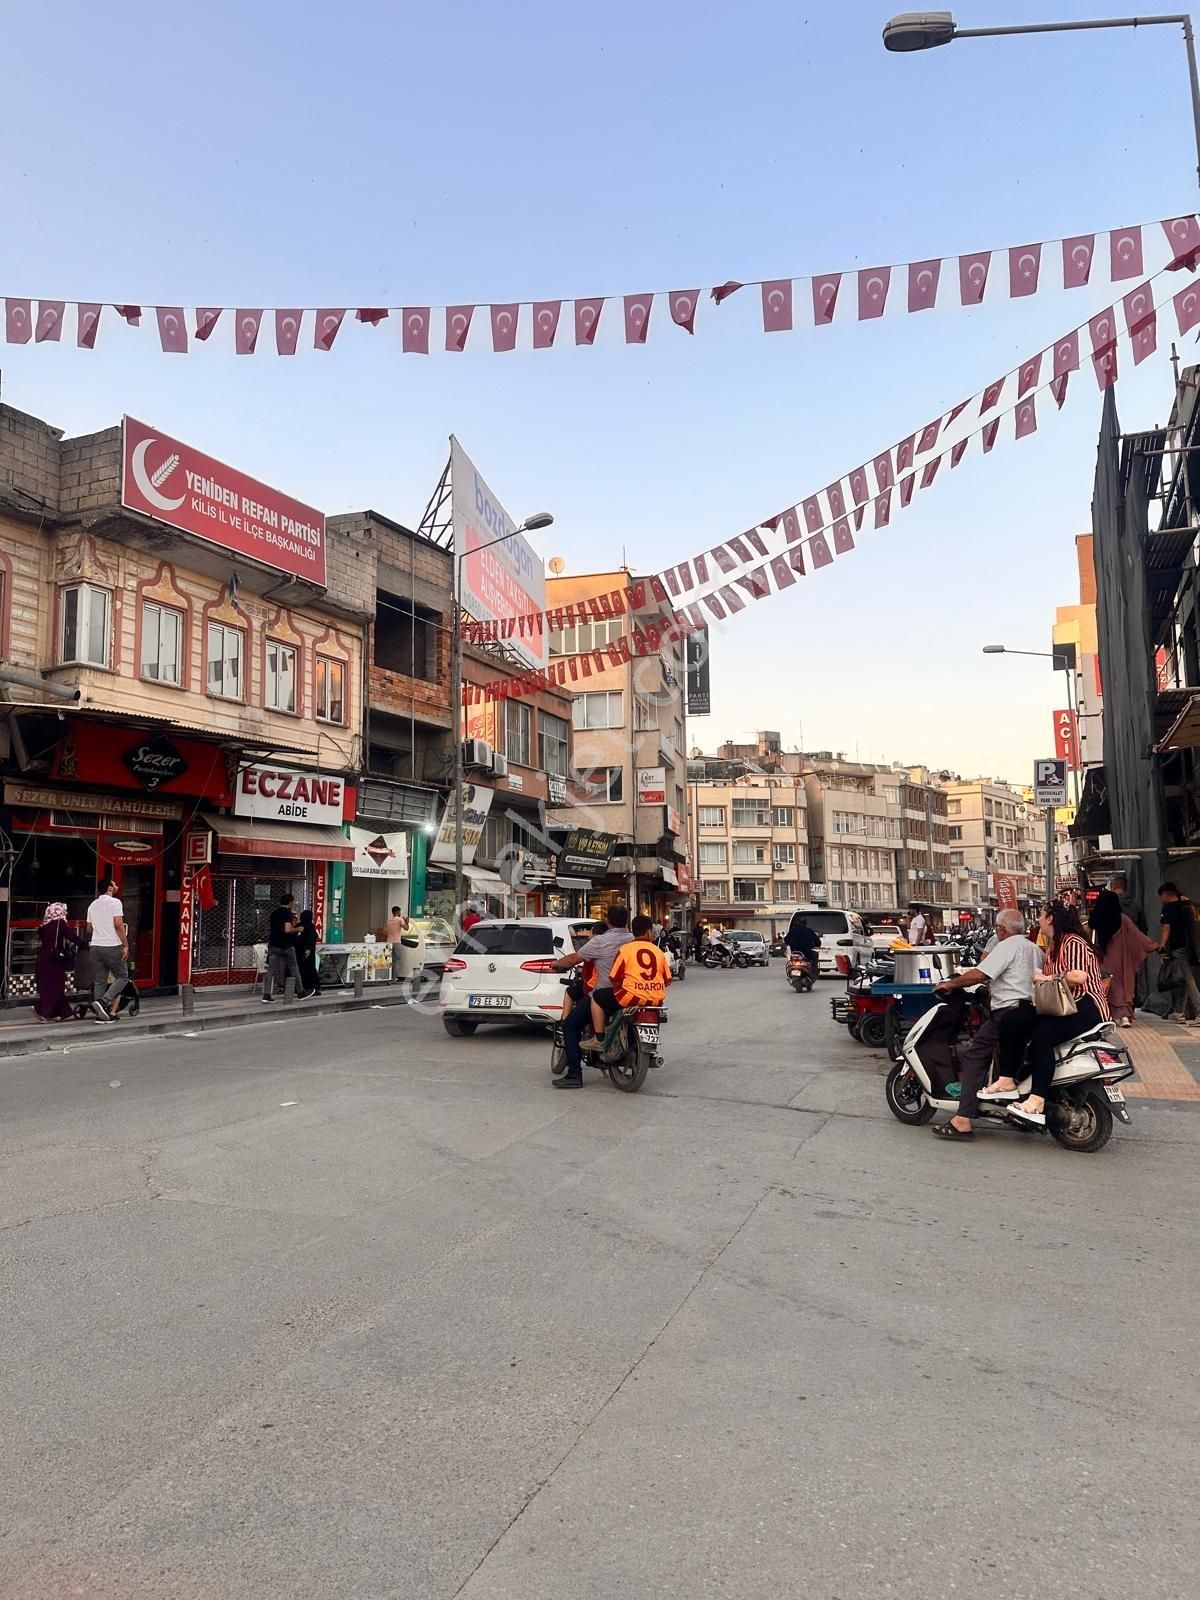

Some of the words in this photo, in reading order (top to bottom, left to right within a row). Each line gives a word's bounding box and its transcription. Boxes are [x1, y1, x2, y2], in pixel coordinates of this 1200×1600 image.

[185, 469, 239, 510] YENİDEN
[242, 496, 278, 529] REFAH
[281, 514, 321, 548] PARTİSİ
[191, 497, 217, 519] KİLİS
[219, 506, 228, 524] İL
[230, 513, 242, 530] VE
[243, 518, 264, 540] İLÇE
[265, 530, 316, 561] BAŞKANLIĞI
[132, 747, 180, 767] Sezer
[147, 777, 160, 787] 3
[241, 767, 341, 807] ECZANE
[14, 790, 57, 805] SEZER
[277, 803, 308, 818] ABİDE
[180, 864, 192, 950] ECZANE
[315, 875, 325, 944] ECZAN
[636, 948, 658, 982] 9
[634, 982, 664, 992] ICARDI
[484, 997, 493, 1006] EE
